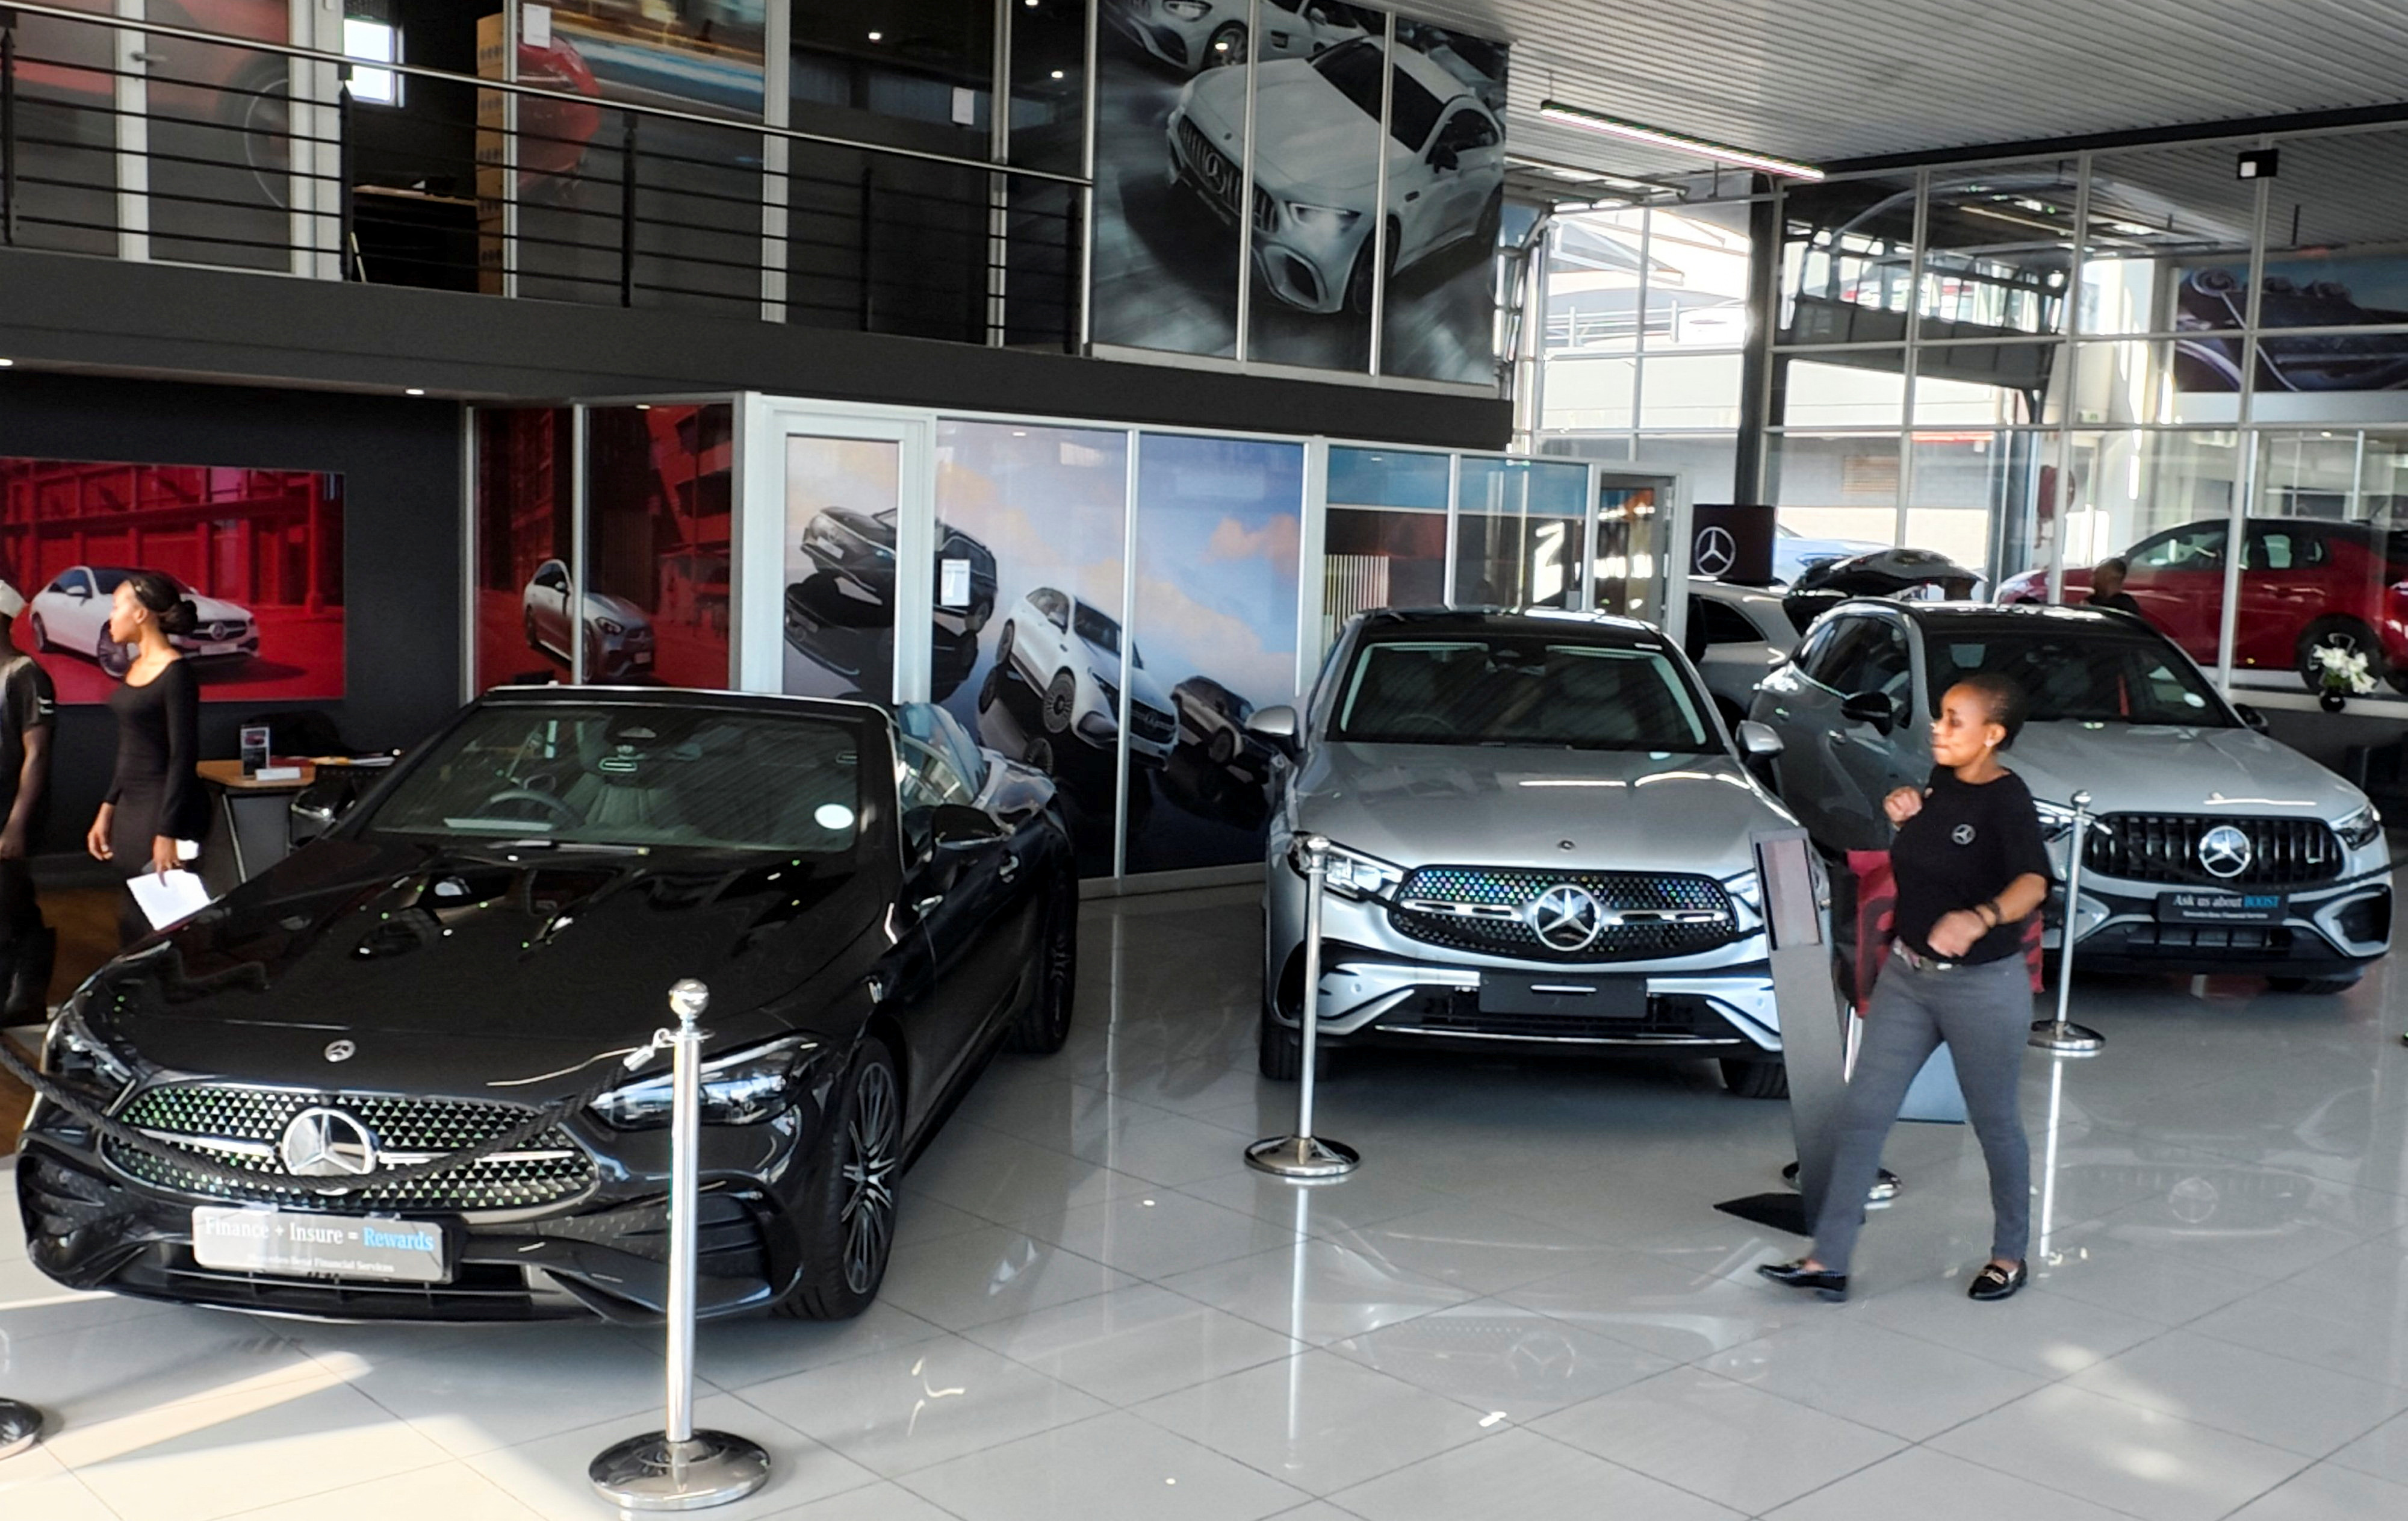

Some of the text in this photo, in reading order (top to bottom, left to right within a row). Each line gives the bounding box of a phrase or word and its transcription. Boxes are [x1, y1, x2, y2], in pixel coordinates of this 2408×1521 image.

[2173, 895, 2194, 906] Ask
[2198, 898, 2210, 907] us
[2213, 896, 2242, 907] about
[205, 1216, 434, 1251] Finance + Insure = Rewards
